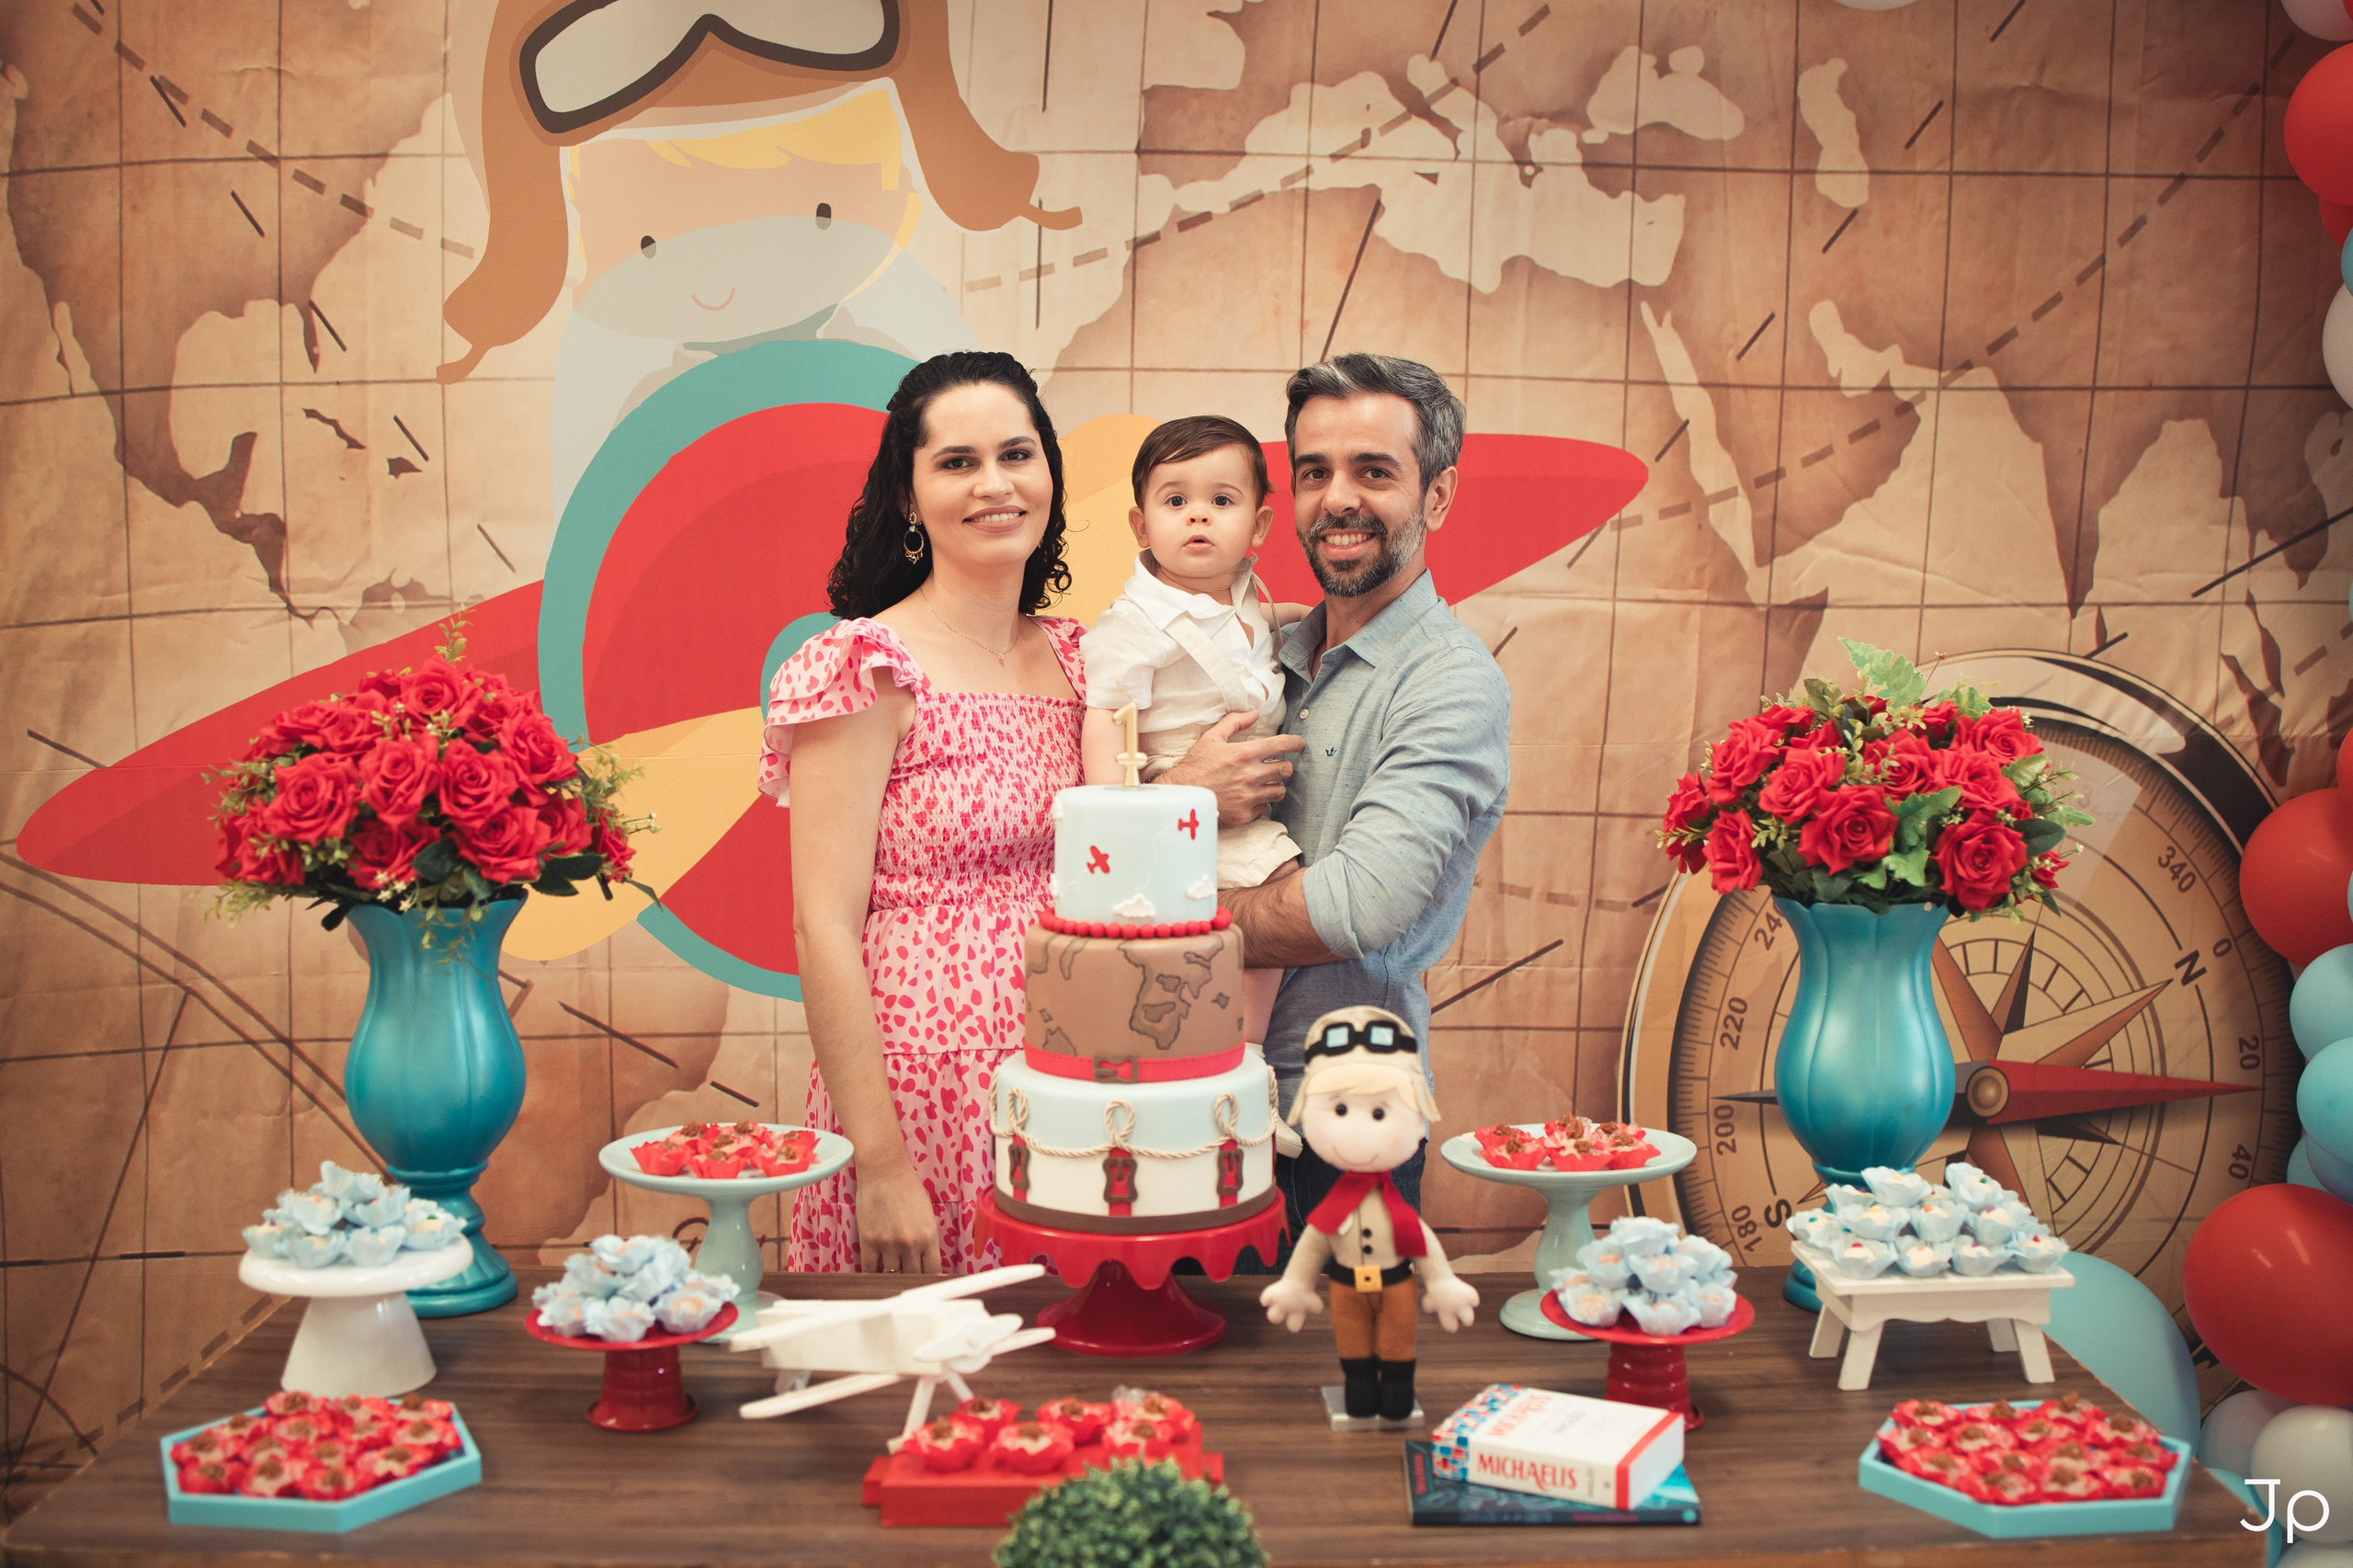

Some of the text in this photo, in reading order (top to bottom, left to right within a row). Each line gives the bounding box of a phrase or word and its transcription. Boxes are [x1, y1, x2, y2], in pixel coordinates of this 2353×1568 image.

[2157, 846, 2196, 893] 340
[1754, 903, 1785, 950] 24
[2212, 937, 2232, 958] 0
[2174, 949, 2207, 987] N
[1720, 997, 1747, 1051] 220
[2239, 1035, 2260, 1070] 20
[1714, 1105, 1736, 1155] 200
[2228, 1143, 2252, 1180] 40
[1732, 1205, 1762, 1252] 180
[1765, 1199, 1791, 1228] S
[1477, 1452, 1577, 1491] MICHAELIS
